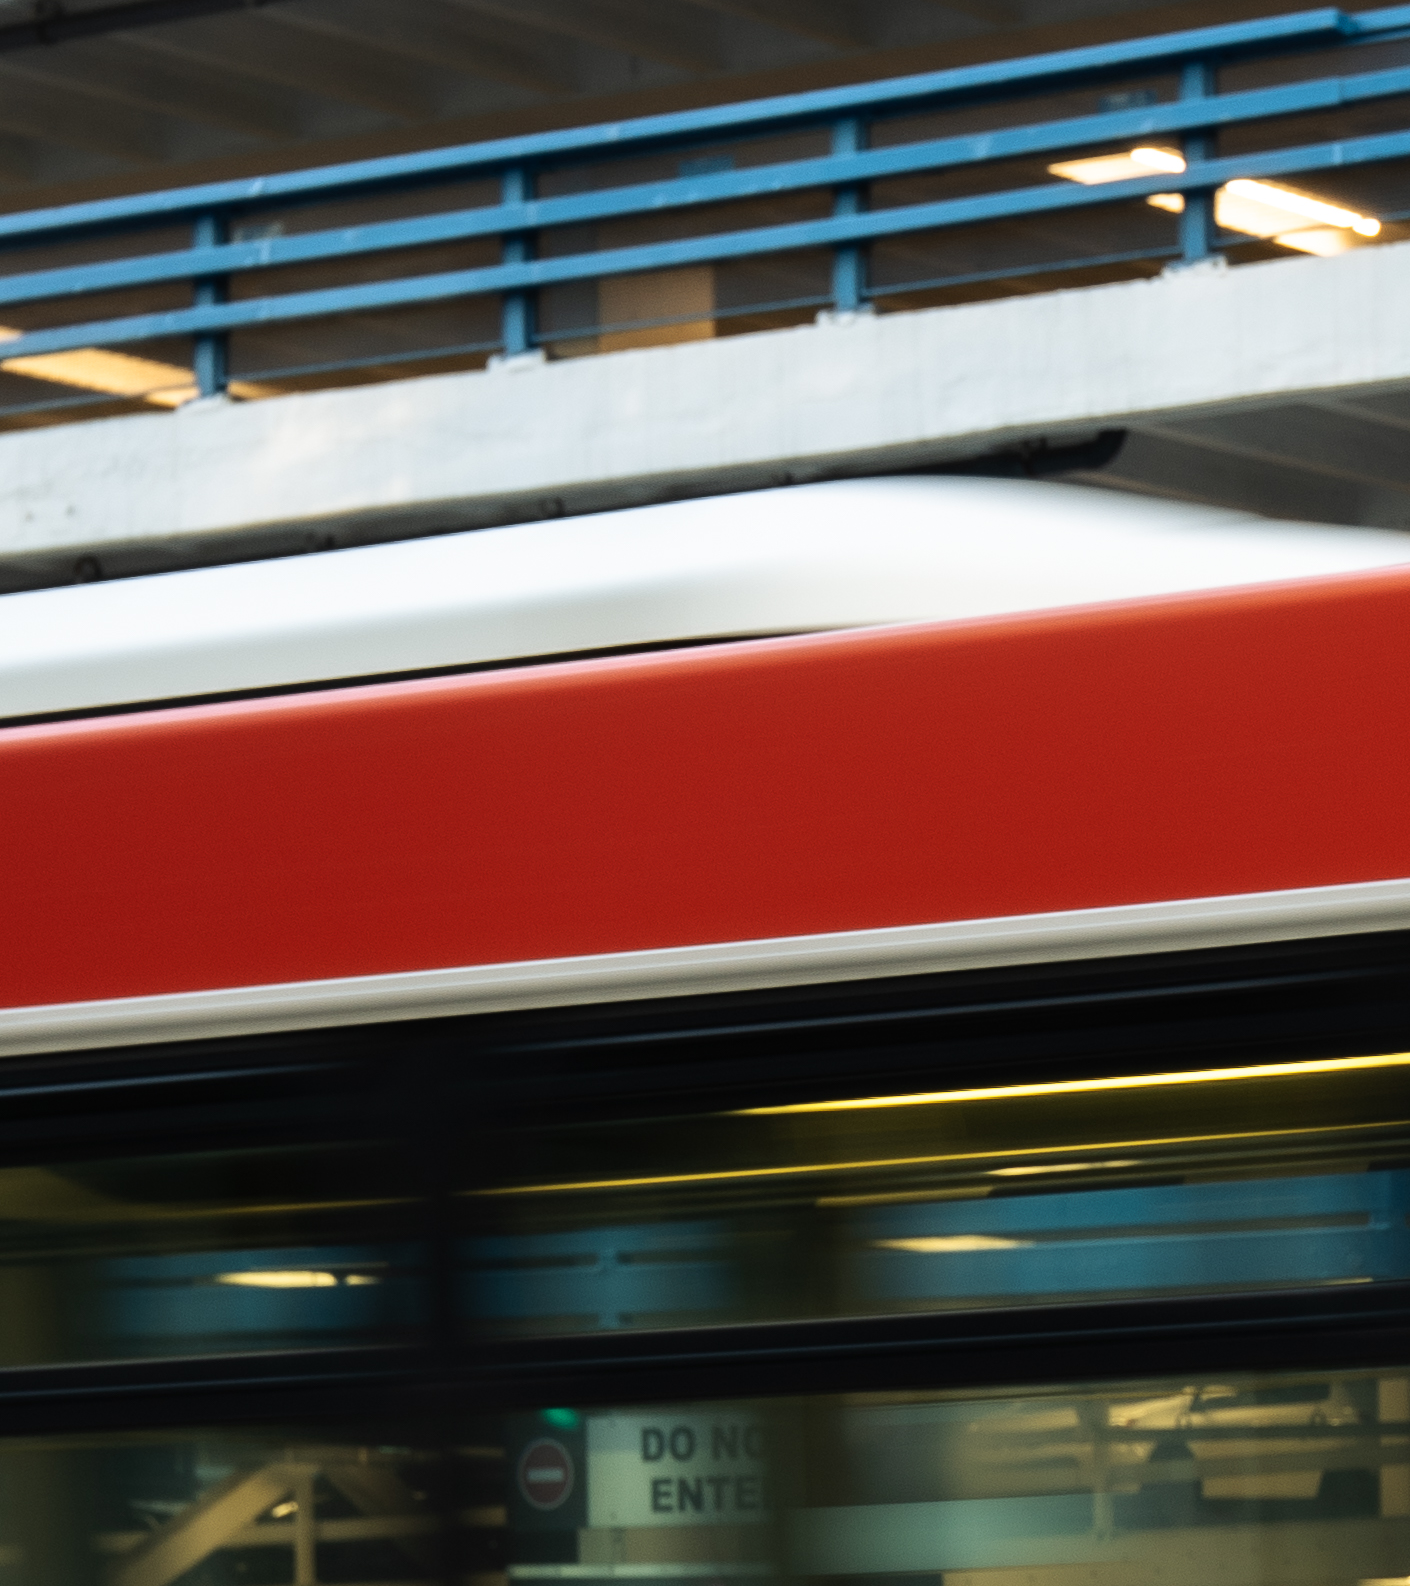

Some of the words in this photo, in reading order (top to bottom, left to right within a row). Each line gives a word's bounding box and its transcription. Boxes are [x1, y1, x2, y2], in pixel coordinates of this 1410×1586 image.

[641, 1426, 697, 1462] DO
[711, 1425, 768, 1461] NO
[652, 1475, 762, 1512] ENTE
